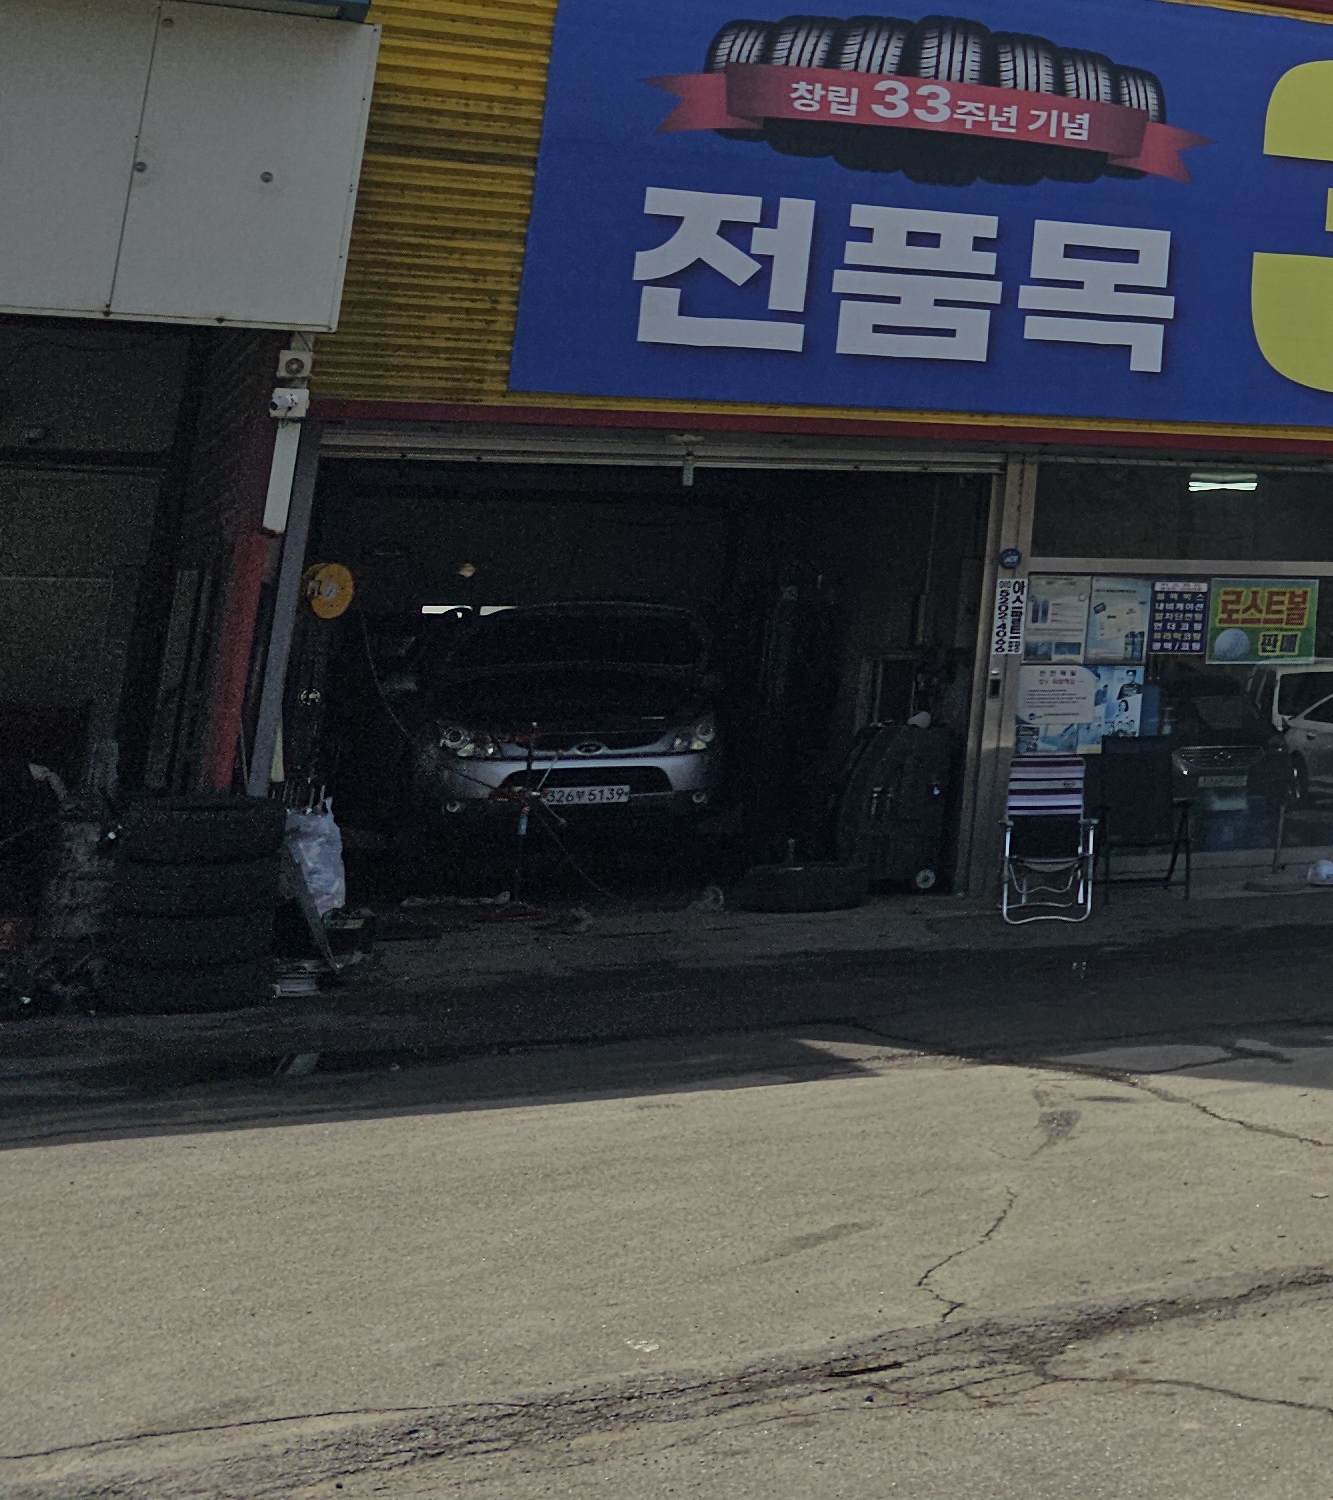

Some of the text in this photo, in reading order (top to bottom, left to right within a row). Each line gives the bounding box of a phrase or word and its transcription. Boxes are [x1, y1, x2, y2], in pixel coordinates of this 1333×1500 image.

[790, 80, 1090, 141] 창립 33주년 기념
[632, 187, 1175, 373] 전품목
[1218, 589, 1310, 626] 로스트볼
[587, 787, 625, 802] 5139
